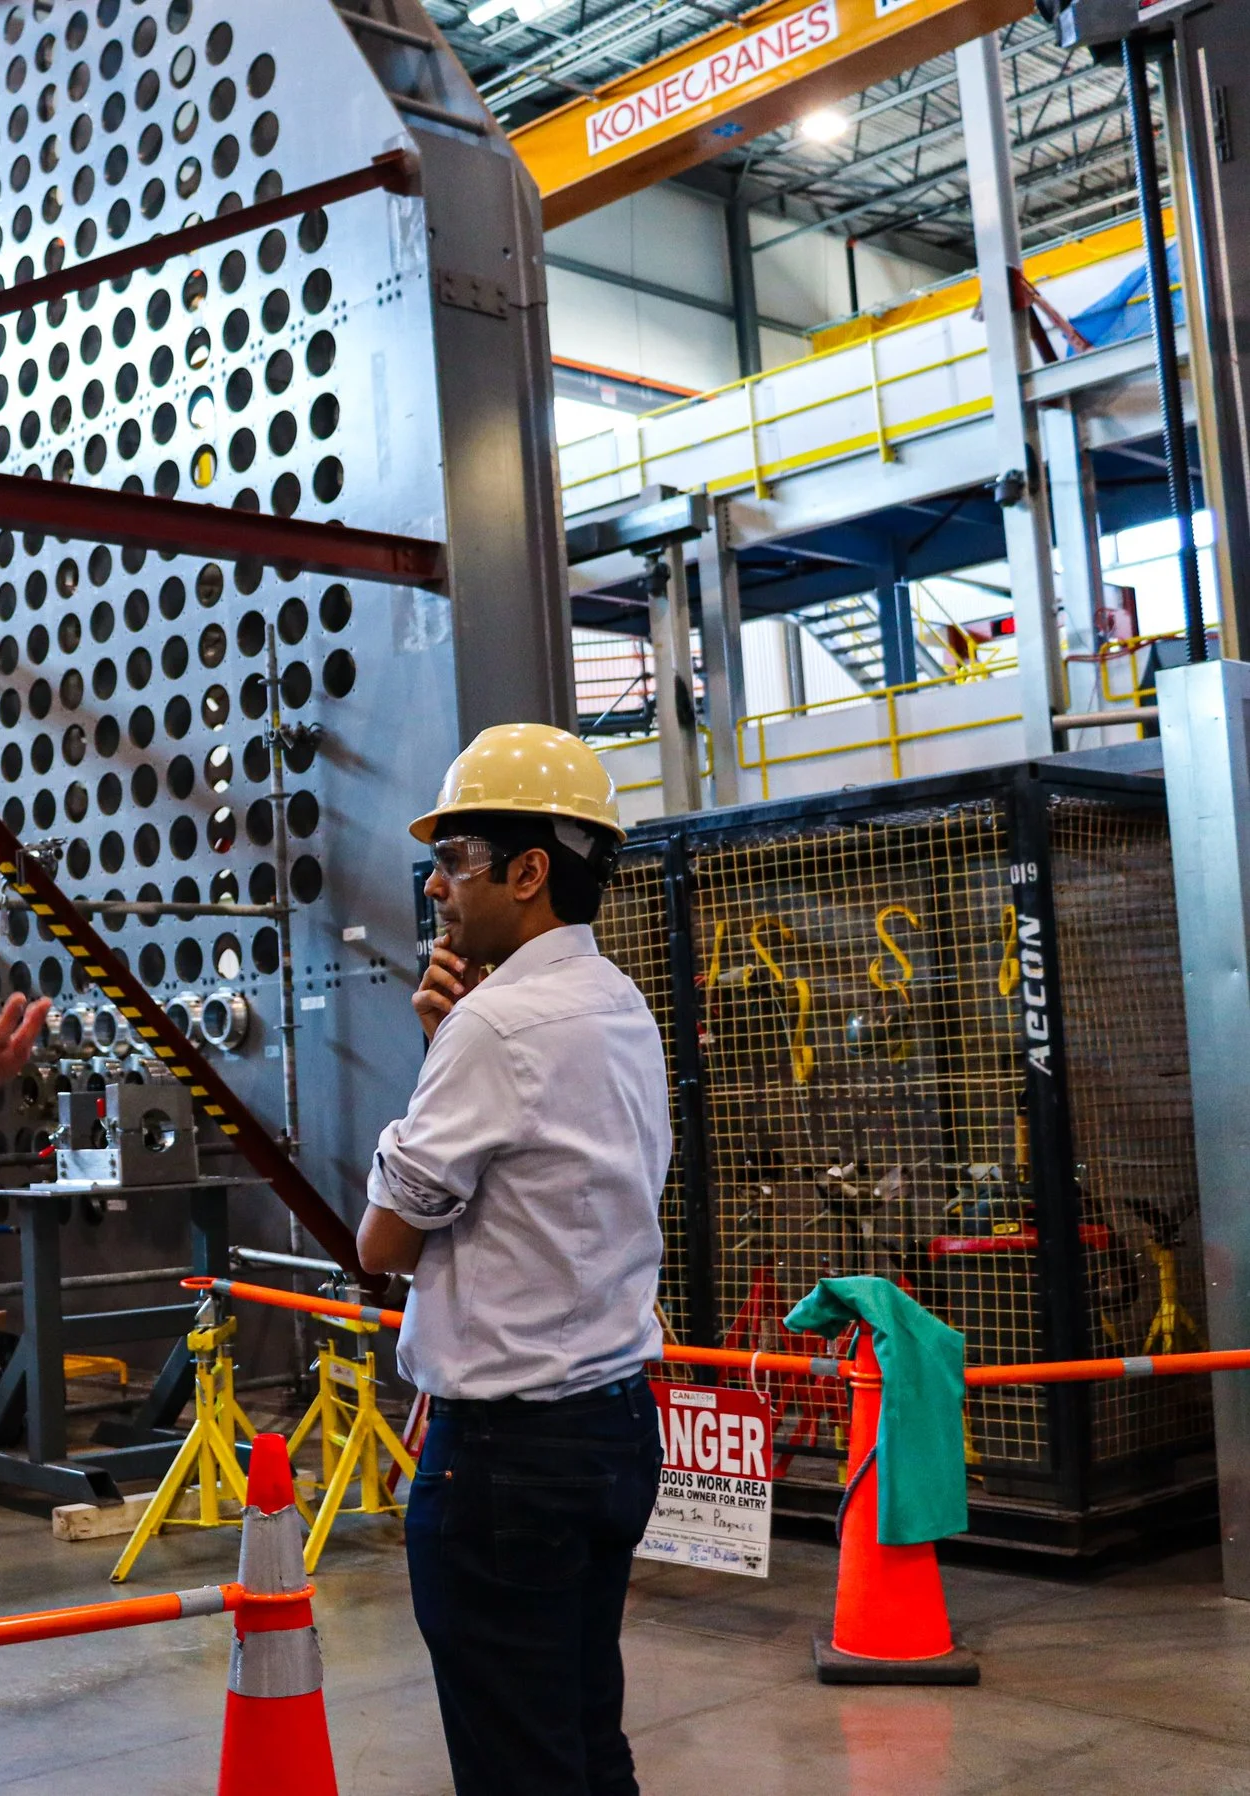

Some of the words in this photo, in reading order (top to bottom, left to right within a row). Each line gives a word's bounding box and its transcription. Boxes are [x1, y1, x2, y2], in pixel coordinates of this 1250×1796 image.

[592, 5, 830, 148] KONECRANES
[1010, 862, 1038, 884] 019
[656, 1406, 766, 1477] NGER
[659, 1470, 693, 1487] DOUS
[696, 1474, 732, 1493] WORK
[735, 1480, 767, 1498] AREA
[663, 1486, 684, 1498] AREA
[686, 1490, 716, 1503] OWNER
[719, 1494, 736, 1505] FOR
[738, 1497, 767, 1509] ENTRY
